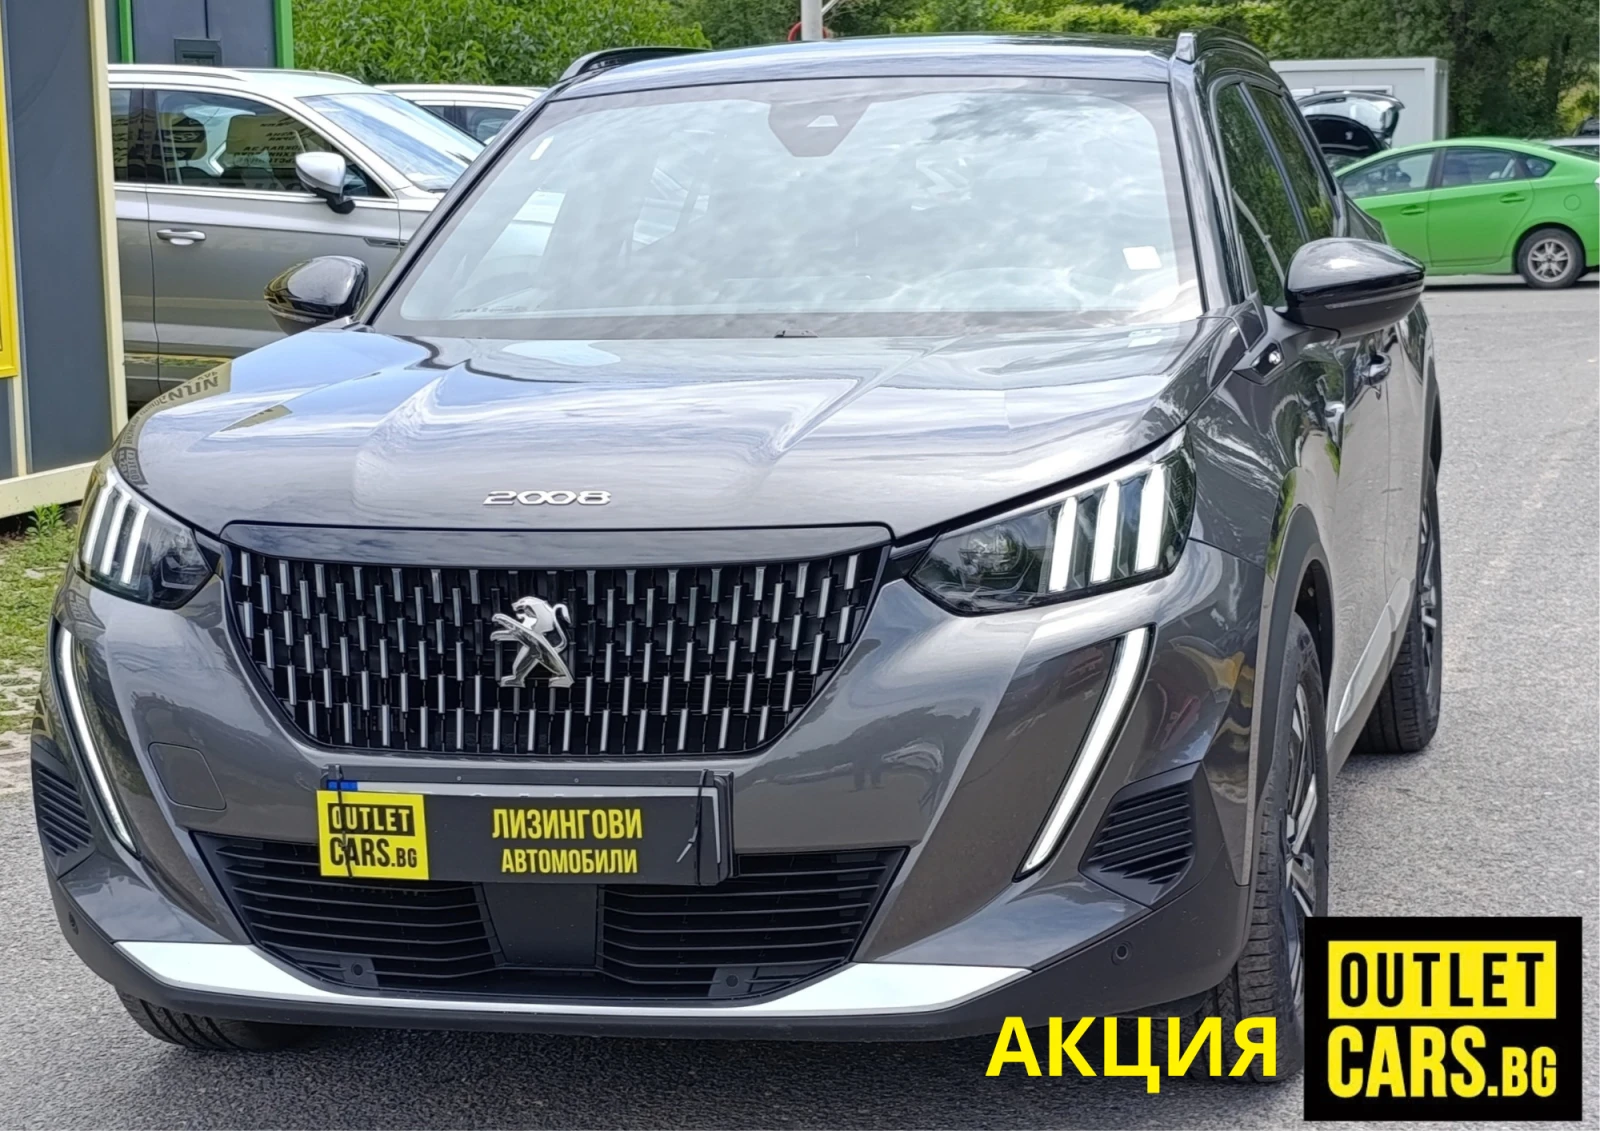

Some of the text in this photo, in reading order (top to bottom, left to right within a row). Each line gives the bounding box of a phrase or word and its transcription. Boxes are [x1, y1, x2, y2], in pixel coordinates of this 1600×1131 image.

[483, 490, 612, 506] 2008
[331, 805, 410, 832] OUTLET
[492, 808, 643, 839] ЛИЗИНГОВИ
[329, 836, 418, 869] CARS.BG
[501, 848, 638, 874] АВТОМОБИЛИ
